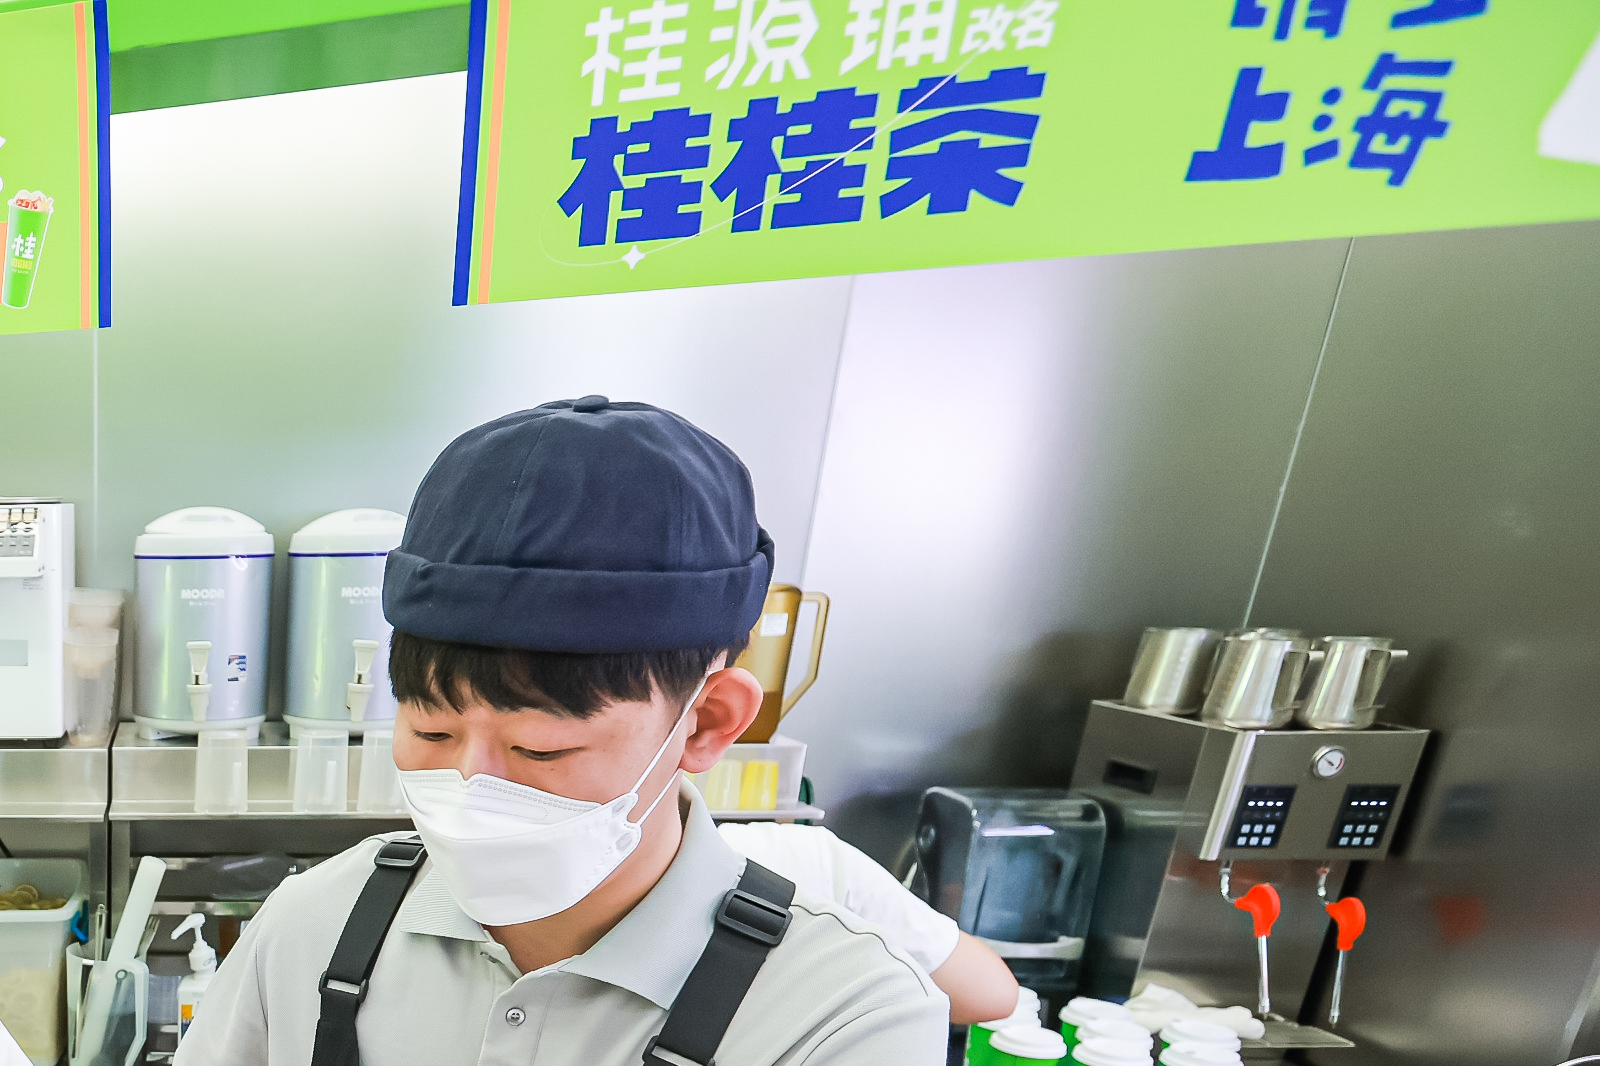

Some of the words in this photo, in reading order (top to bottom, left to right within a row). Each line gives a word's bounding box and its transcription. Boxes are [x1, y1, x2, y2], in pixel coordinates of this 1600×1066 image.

[959, 0, 1061, 55] 改名
[1184, 52, 1454, 188] 上海
[11, 231, 36, 259] 桂
[342, 586, 382, 598] MOOD
